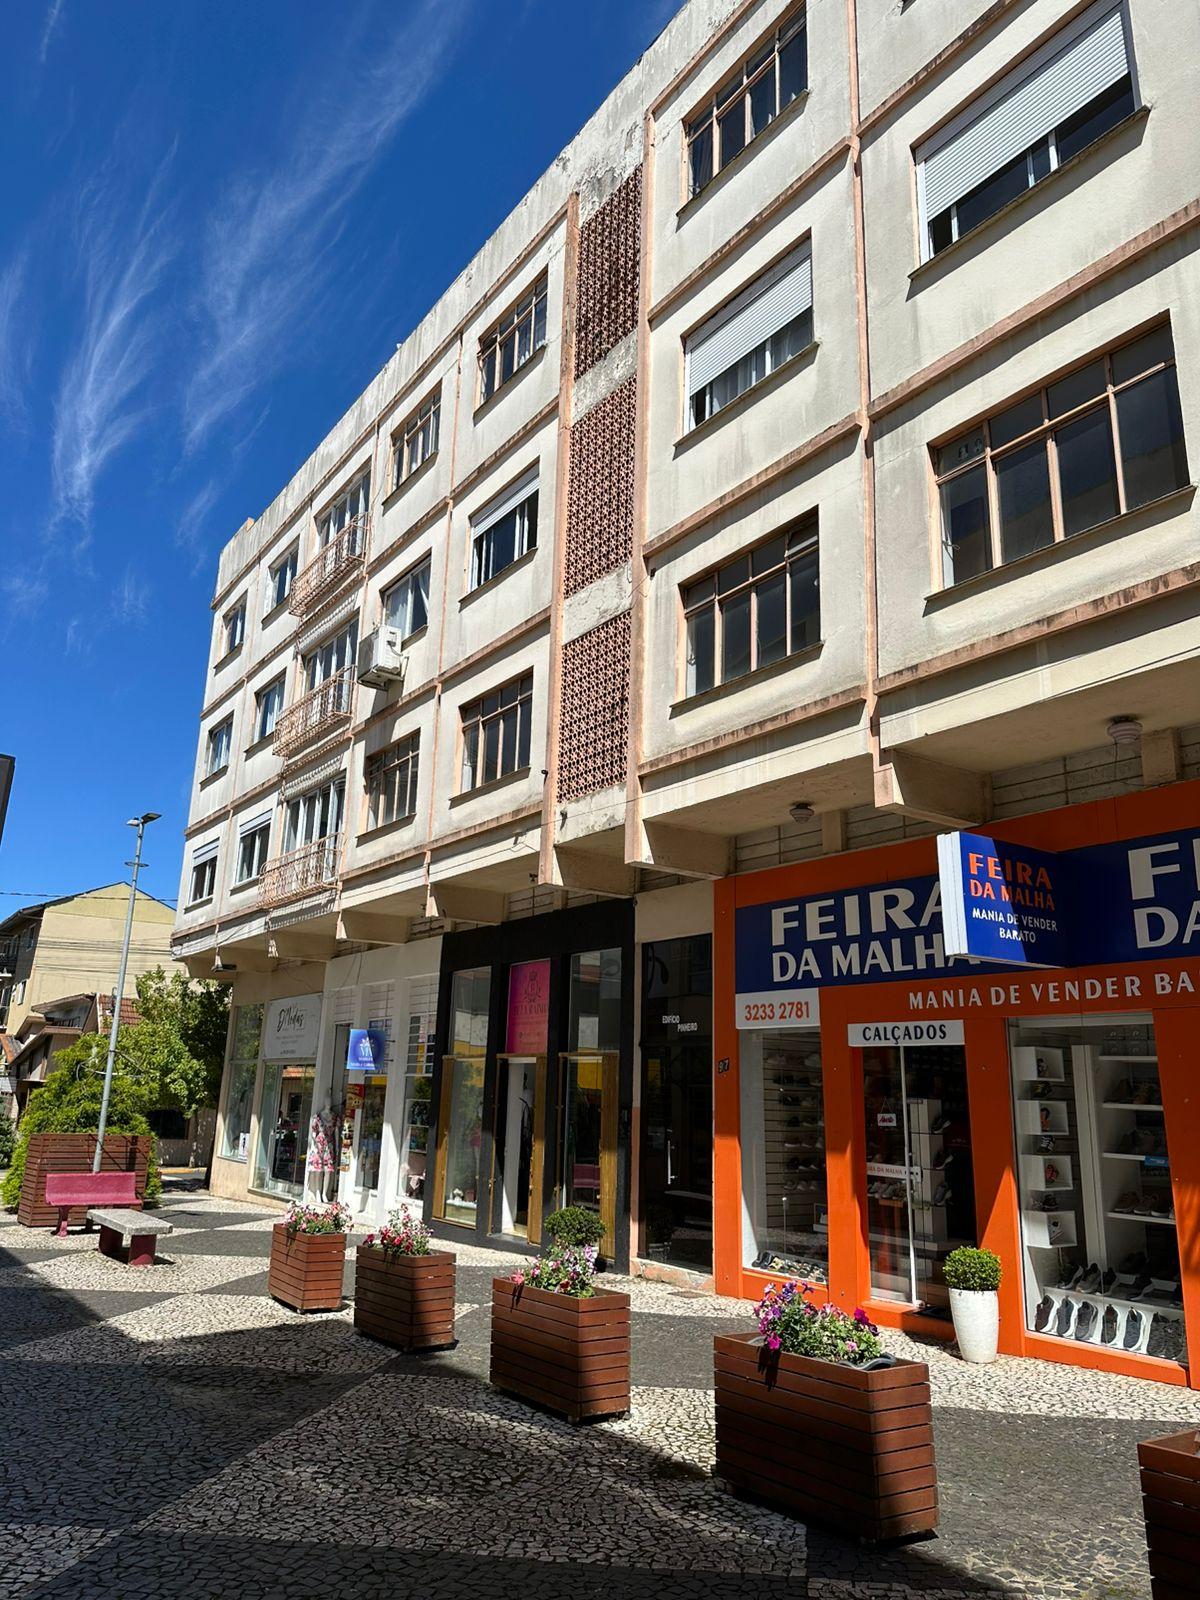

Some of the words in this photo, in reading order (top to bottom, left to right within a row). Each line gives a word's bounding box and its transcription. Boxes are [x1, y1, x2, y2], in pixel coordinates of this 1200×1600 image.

[969, 852, 1053, 890] FEIRA
[1128, 838, 1200, 900] F
[970, 879, 996, 900] DA
[1001, 885, 1056, 912] MALHA
[972, 907, 1005, 923] MANIA
[1007, 913, 1020, 925] DE
[1021, 915, 1058, 932] VENDER
[999, 927, 1036, 943] BARATO
[772, 948, 822, 982] DA
[832, 933, 980, 977] MALH
[909, 988, 982, 1010] MANIA
[990, 985, 1021, 1006] DE
[1031, 976, 1141, 1002] VENDER
[1154, 969, 1200, 995] BA
[744, 1003, 775, 1021] 3233
[779, 1001, 810, 1020] 2781
[862, 1024, 947, 1045] CALÇADOS
